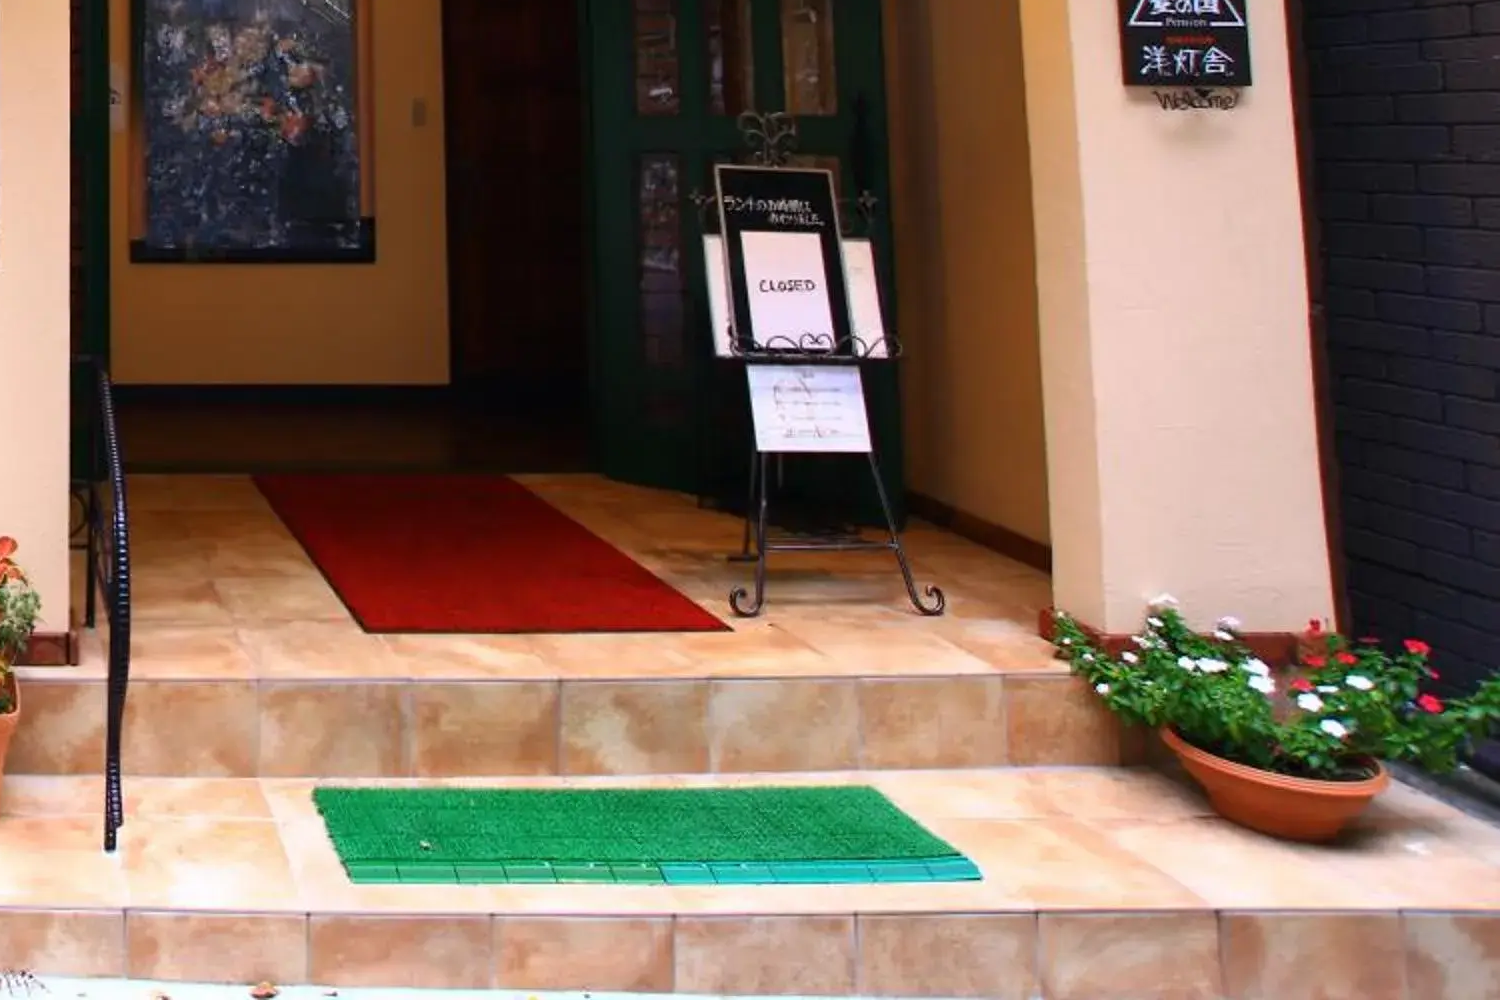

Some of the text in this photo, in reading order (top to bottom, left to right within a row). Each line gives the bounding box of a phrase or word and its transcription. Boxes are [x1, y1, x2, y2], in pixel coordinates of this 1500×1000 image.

[1141, 44, 1234, 75] 洋灯舎
[759, 279, 816, 293] CLOSED
